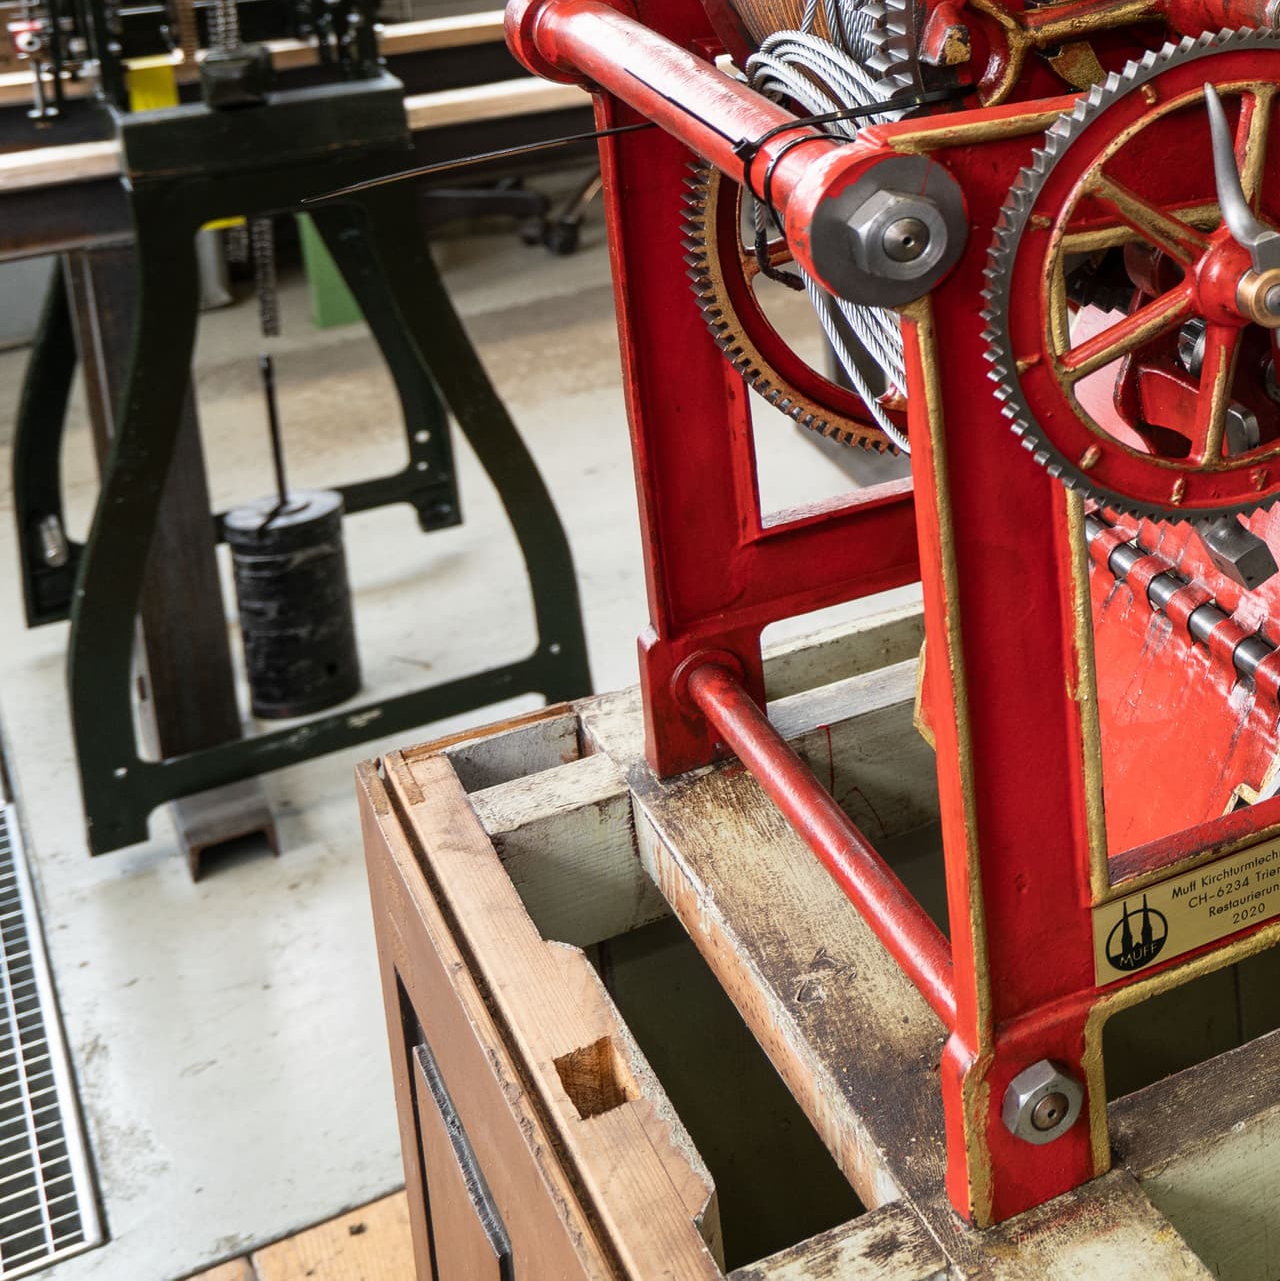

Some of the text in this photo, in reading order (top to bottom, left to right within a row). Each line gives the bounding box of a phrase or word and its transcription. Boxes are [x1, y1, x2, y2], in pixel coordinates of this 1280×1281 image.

[1171, 879, 1197, 900] Muff
[1188, 877, 1250, 909] CH-6234
[1232, 902, 1266, 925] 2020
[1119, 941, 1159, 968] MUFF
